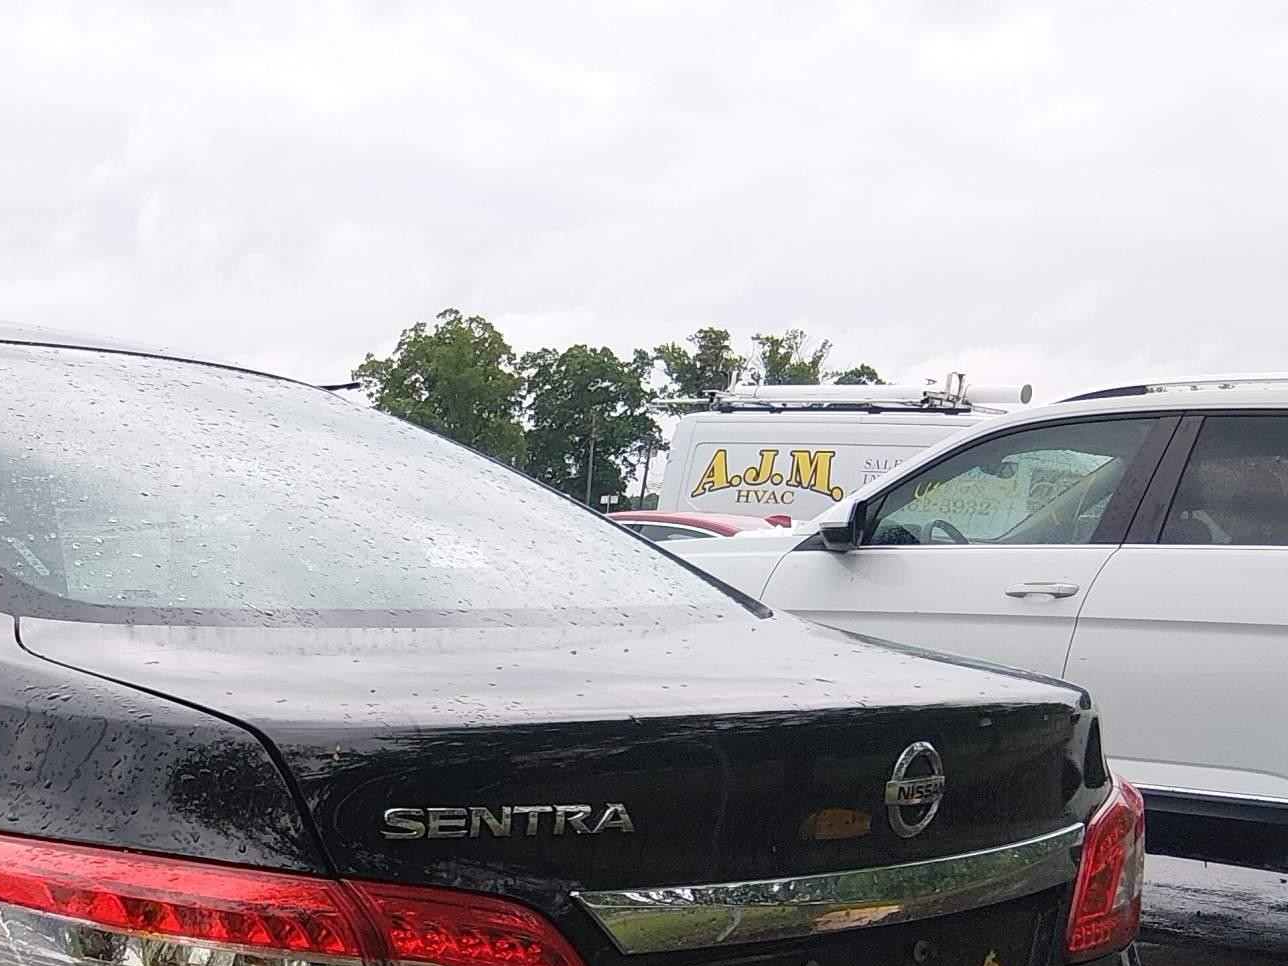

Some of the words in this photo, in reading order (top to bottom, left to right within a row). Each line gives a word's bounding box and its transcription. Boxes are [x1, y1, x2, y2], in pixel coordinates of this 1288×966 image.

[691, 449, 844, 502] A.J.M.
[736, 490, 795, 504] HVAC
[380, 803, 635, 839] SENTRA
